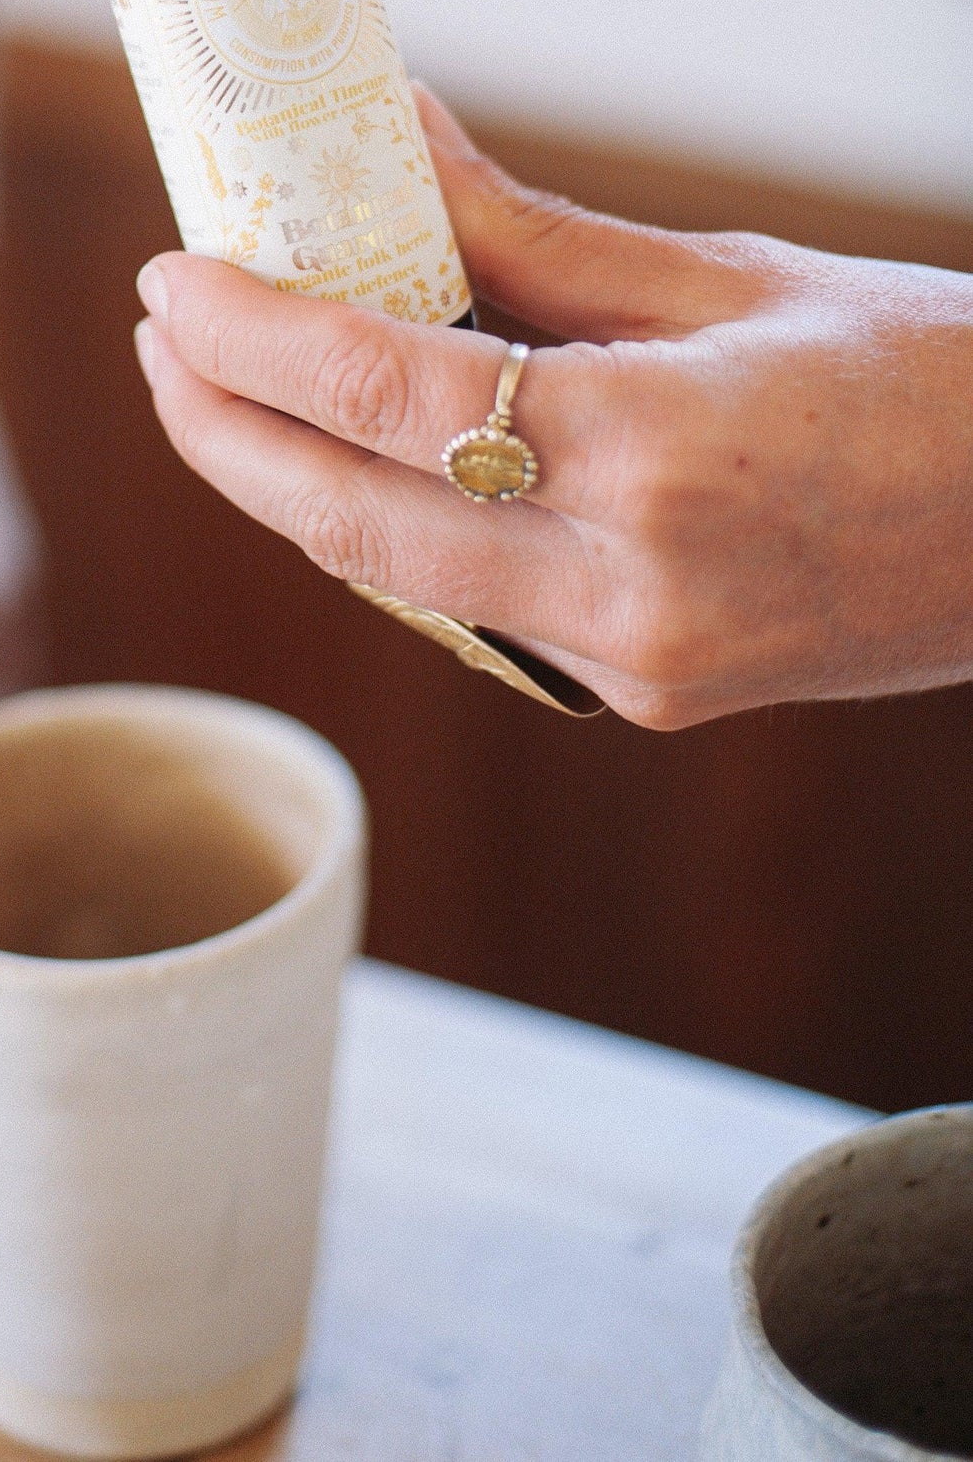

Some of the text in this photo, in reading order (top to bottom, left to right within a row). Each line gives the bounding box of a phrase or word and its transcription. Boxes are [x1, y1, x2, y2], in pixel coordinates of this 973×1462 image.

[230, 37, 306, 73] CONSUMPTION
[308, 47, 332, 68] WITH
[332, 2, 355, 50] PURPOSE
[236, 73, 389, 137] Botanical Tincture
[250, 126, 285, 143] with
[289, 110, 338, 133] flower
[279, 178, 415, 246] Botanical
[292, 210, 420, 272] Guardian
[275, 230, 432, 293] Organic folk herbs
[353, 261, 419, 298] defence
